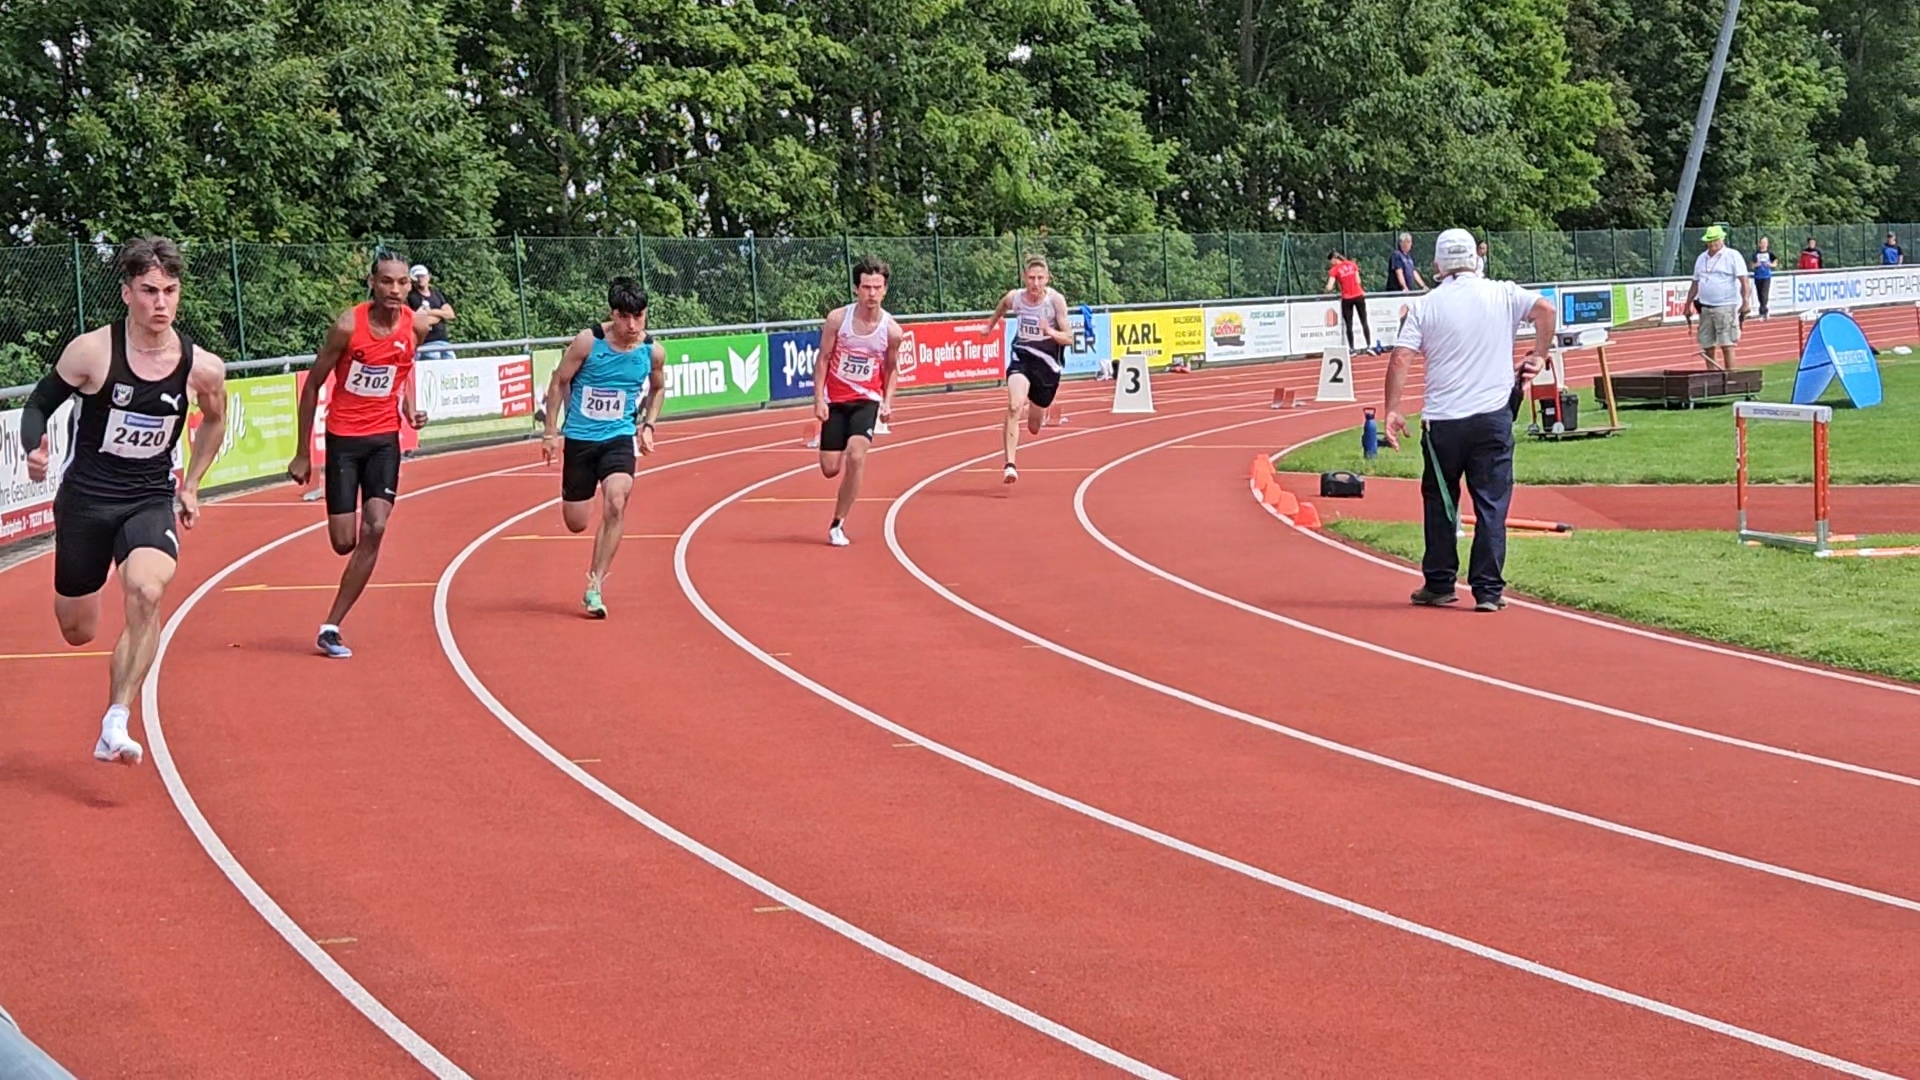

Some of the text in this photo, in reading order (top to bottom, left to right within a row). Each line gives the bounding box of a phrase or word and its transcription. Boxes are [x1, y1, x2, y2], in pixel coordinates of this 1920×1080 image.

[1798, 279, 1861, 302] SONOTRONIC
[1865, 275, 1920, 298] SPORTPAR
[1117, 323, 1162, 346] KARL
[919, 343, 933, 363] Da
[963, 339, 981, 359] Tier
[982, 338, 1000, 363] gut!
[842, 361, 870, 376] 2376
[1329, 358, 1344, 383] 2
[352, 373, 389, 389] 2102
[1125, 367, 1141, 394] 3
[587, 397, 621, 412] 2014
[113, 427, 166, 447] 2420
